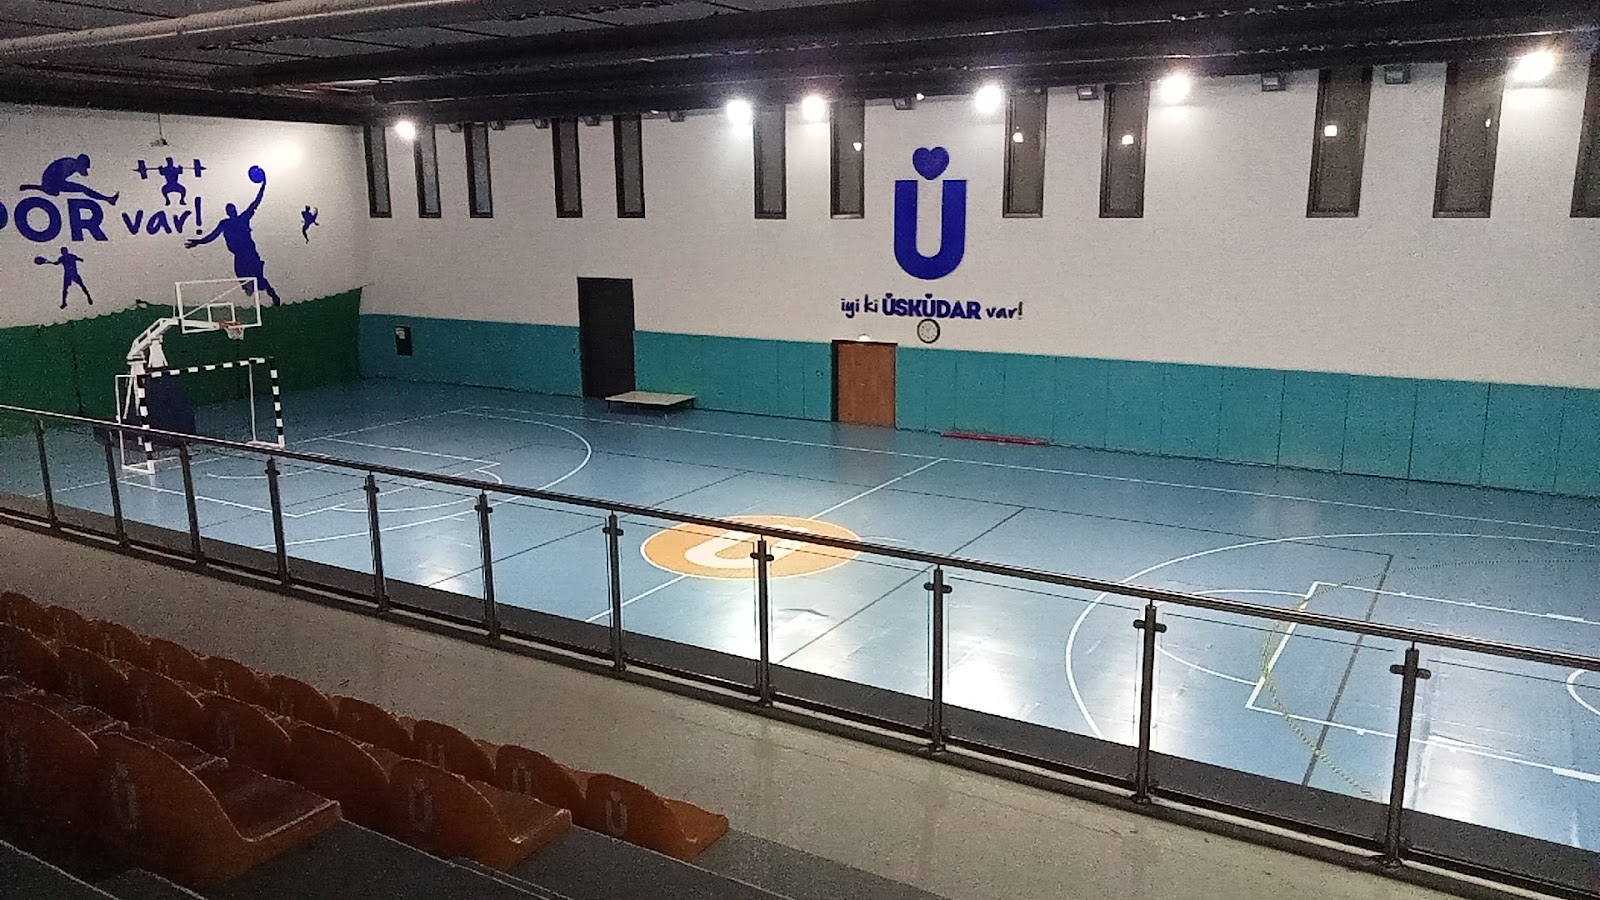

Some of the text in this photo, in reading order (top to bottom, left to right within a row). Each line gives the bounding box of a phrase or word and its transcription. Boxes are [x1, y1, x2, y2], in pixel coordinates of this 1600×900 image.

[0, 196, 203, 242] OR var!
[841, 293, 1023, 320] iyi ki ÜSKÜDAR var!
